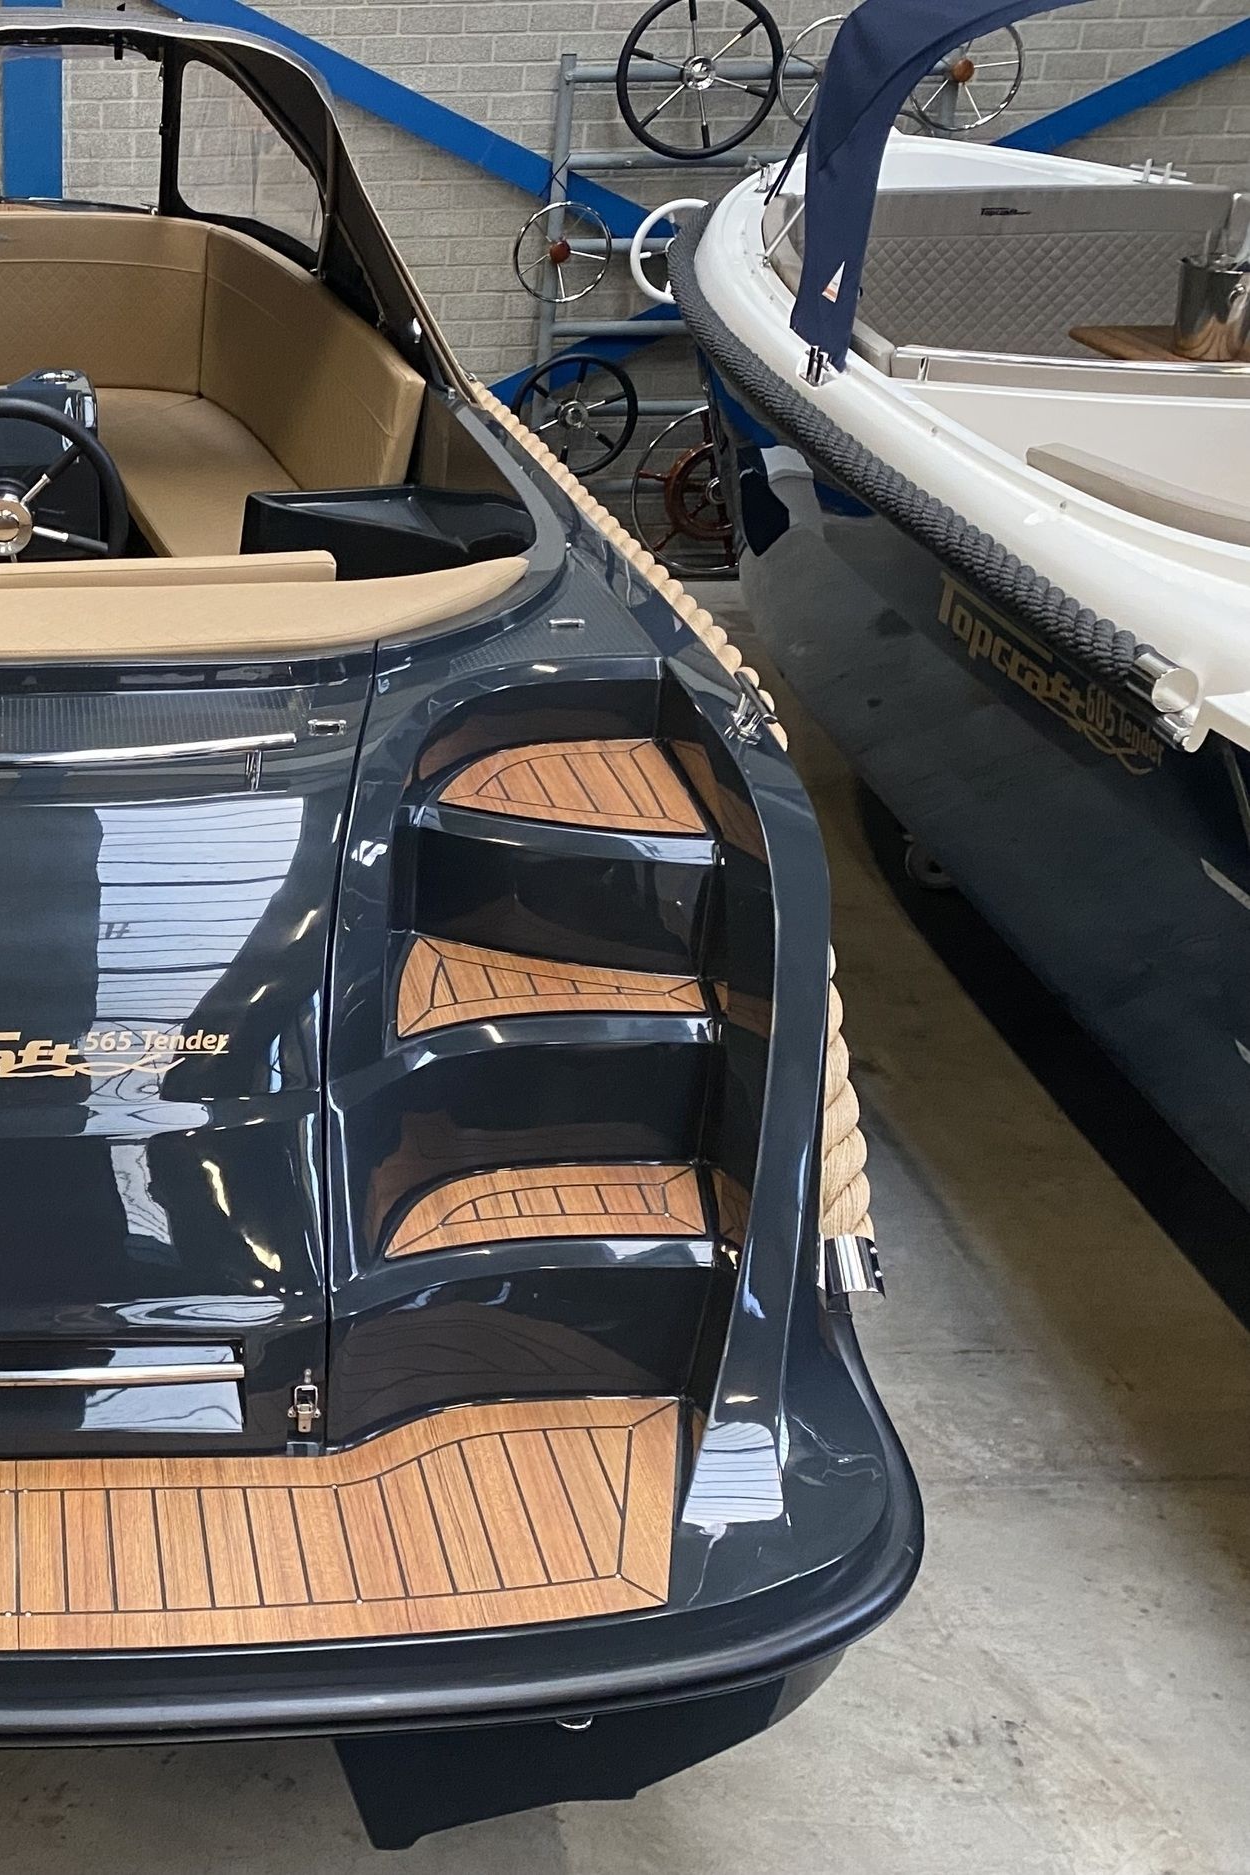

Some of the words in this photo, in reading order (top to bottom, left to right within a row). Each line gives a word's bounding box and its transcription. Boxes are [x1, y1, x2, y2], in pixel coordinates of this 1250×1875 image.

[937, 570, 1086, 719] Topcraft
[1086, 683, 1116, 737] 605
[1116, 703, 1165, 767] Tender
[83, 1030, 133, 1051] 565
[141, 1029, 230, 1051] Tender
